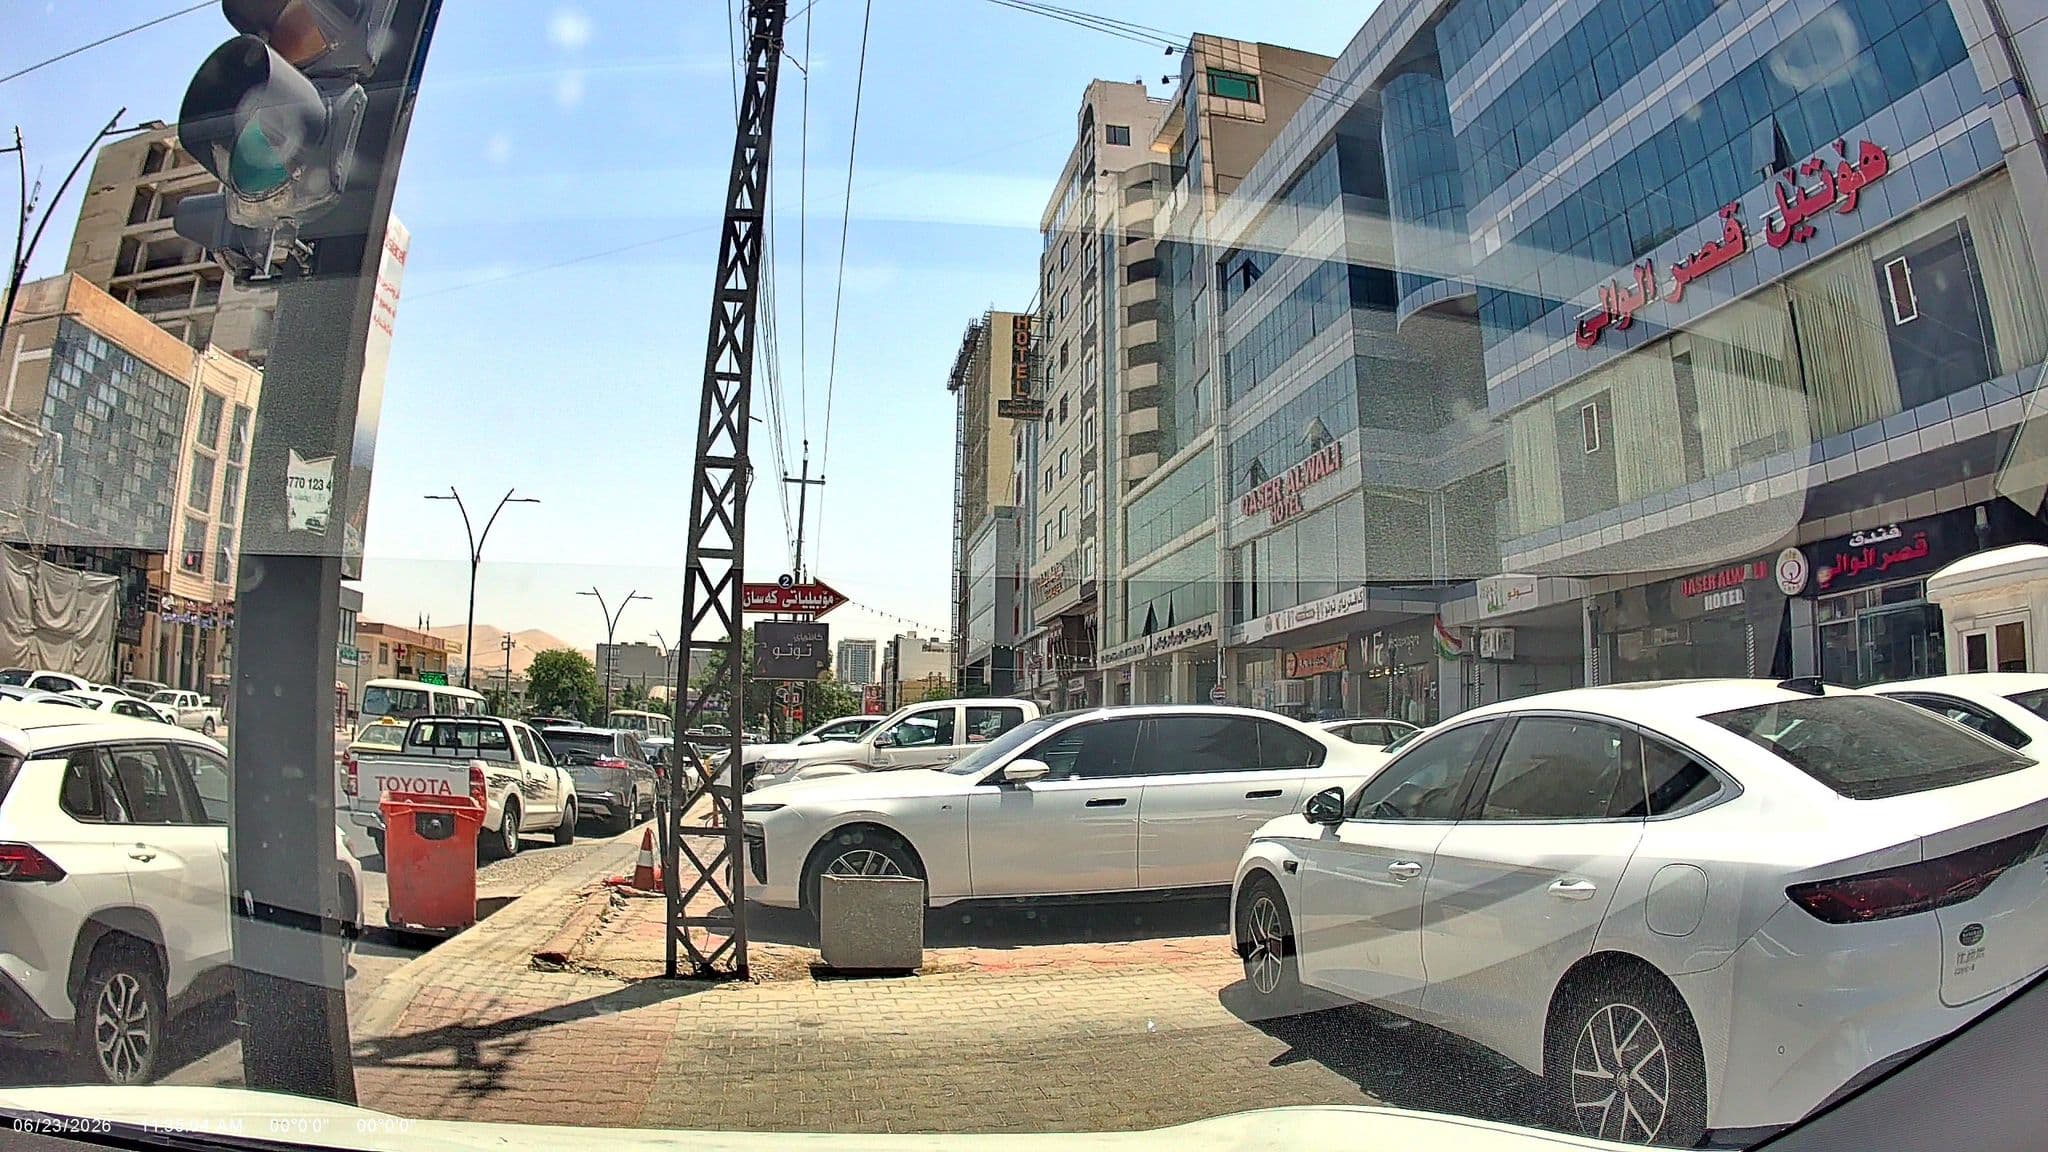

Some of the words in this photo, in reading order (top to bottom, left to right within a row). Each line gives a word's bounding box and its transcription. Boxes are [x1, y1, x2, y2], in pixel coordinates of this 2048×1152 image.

[1664, 201, 1747, 304] قصر
[1016, 316, 1029, 396] HOTEL
[308, 478, 324, 491] 123
[1271, 493, 1303, 524] HOTEL
[1849, 523, 1903, 547] فندق
[1876, 531, 1929, 571] قصر
[782, 576, 790, 587] 2
[375, 776, 452, 795] TOYOTA
